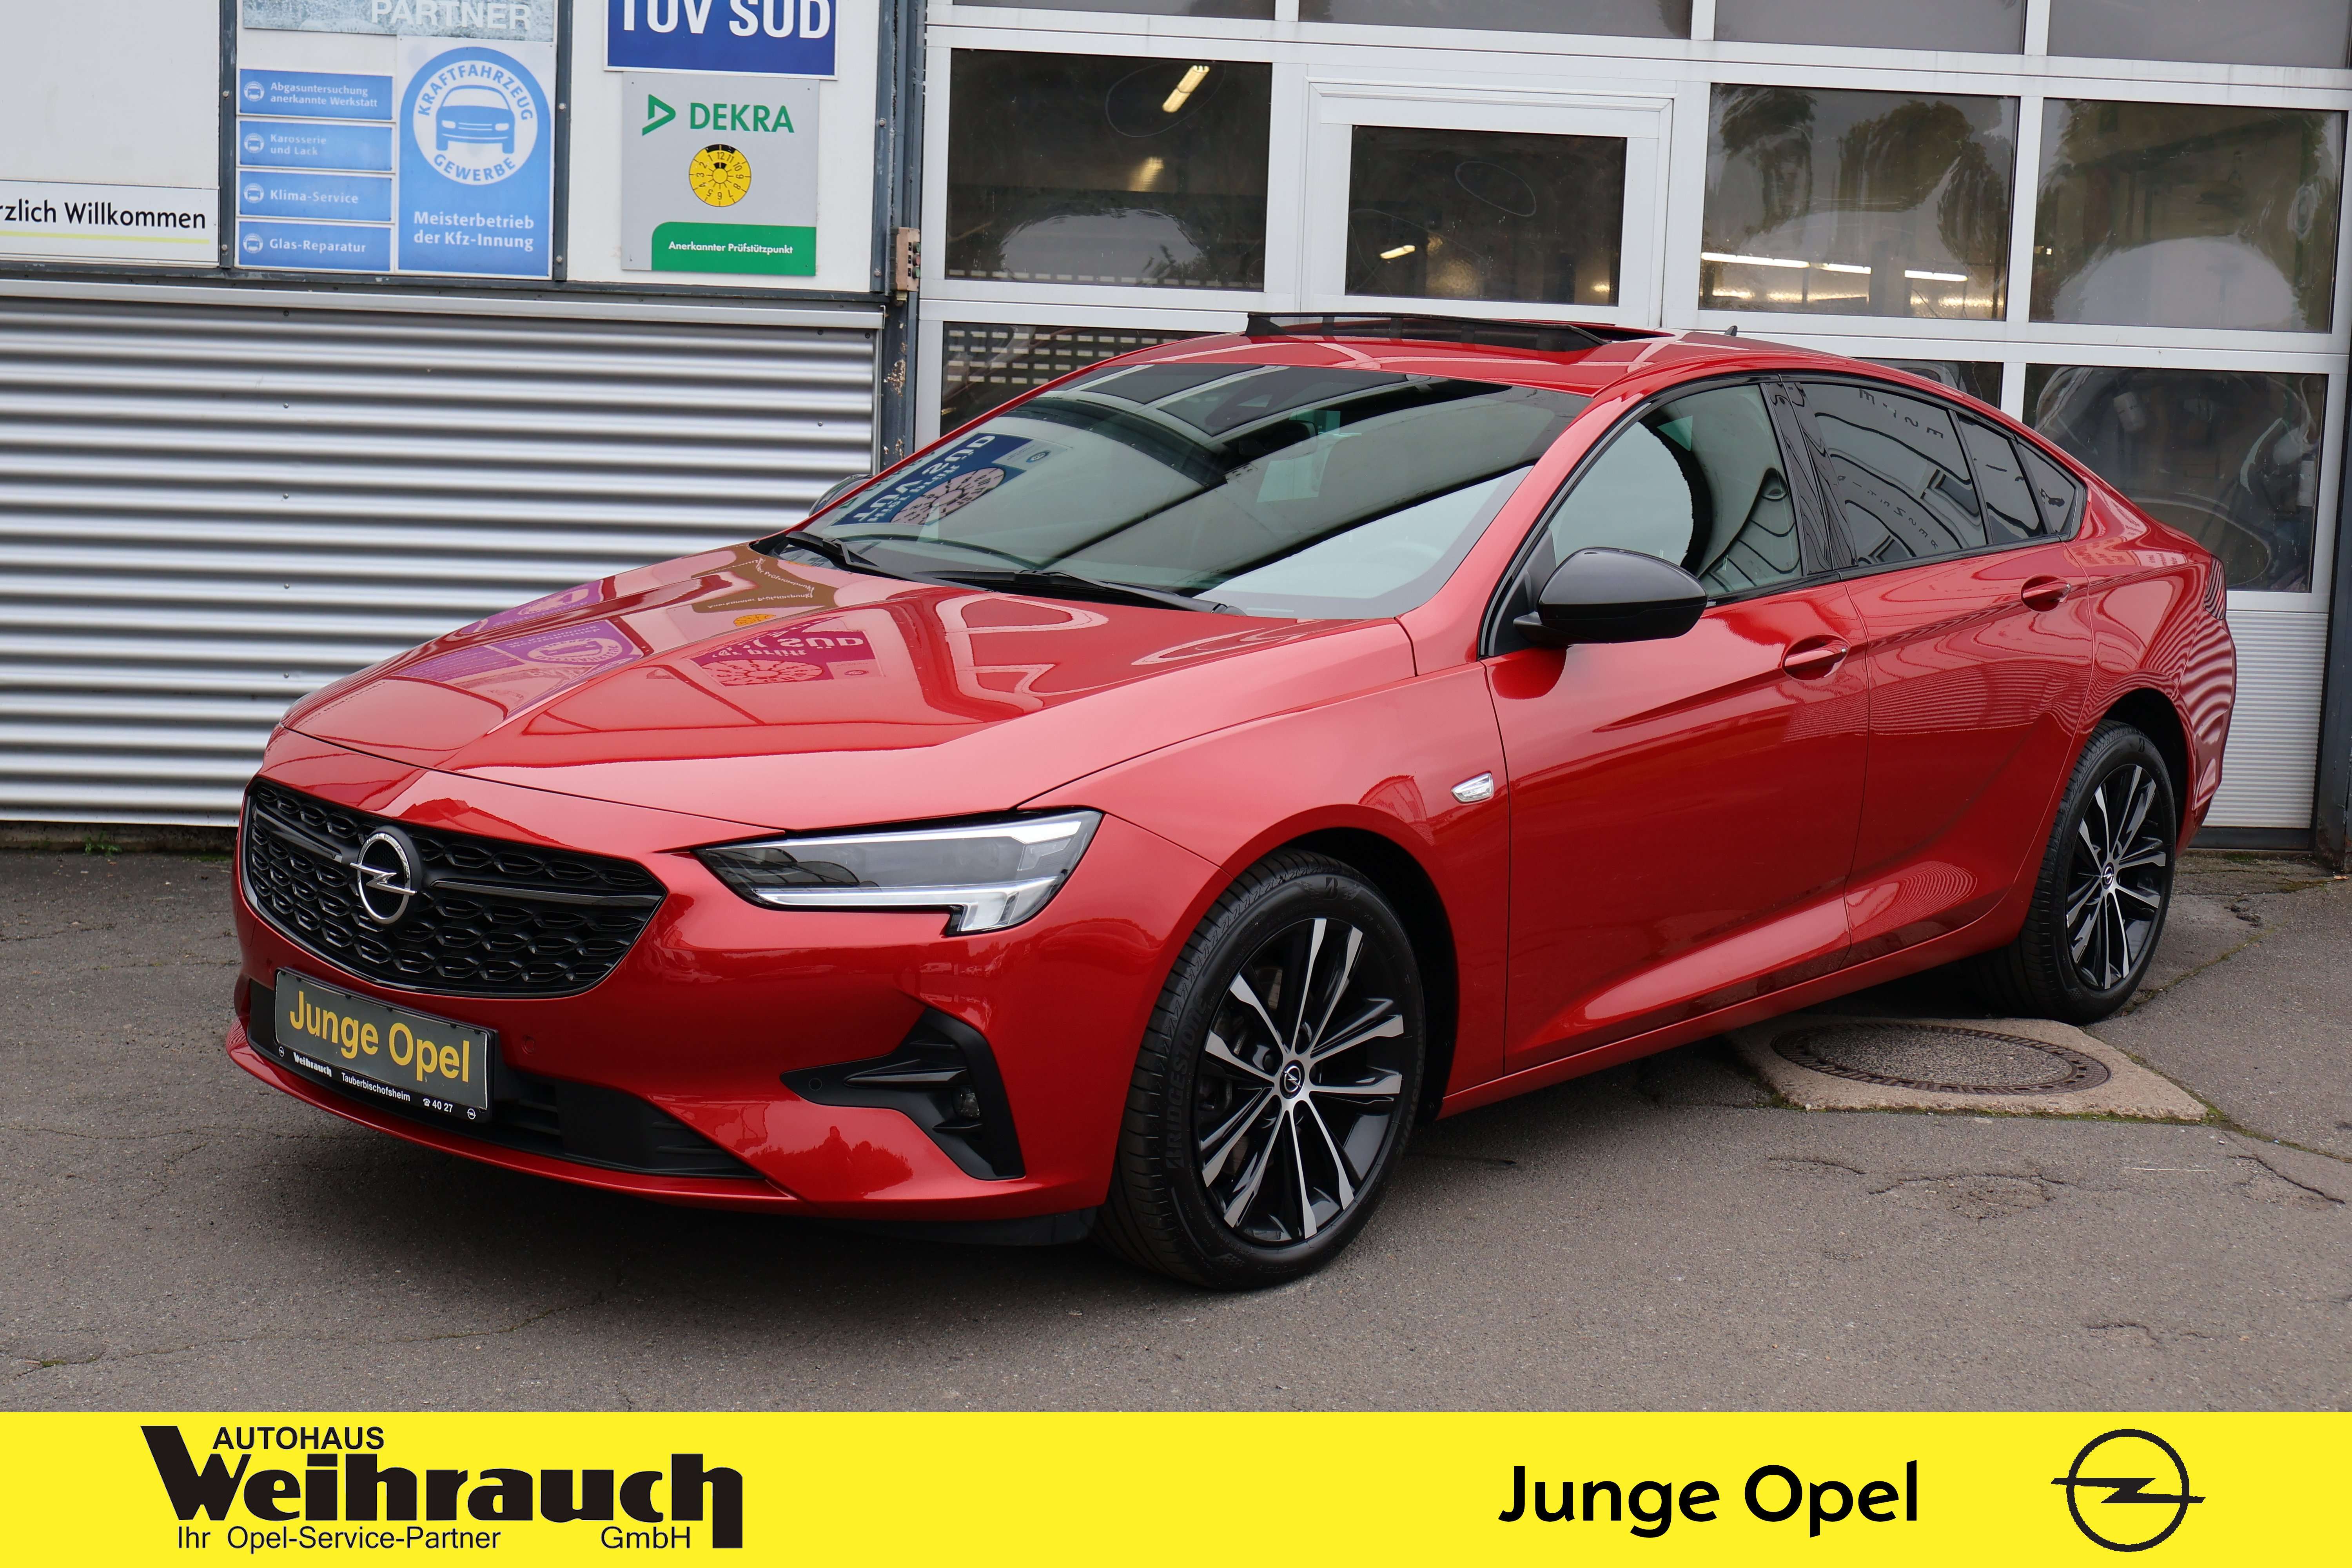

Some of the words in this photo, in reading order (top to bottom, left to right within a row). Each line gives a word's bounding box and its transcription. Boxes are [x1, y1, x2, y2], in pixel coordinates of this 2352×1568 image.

[372, 0, 531, 31] PARTNER
[270, 82, 368, 97] Abgasuntersuchung
[418, 64, 533, 120] KRAFTFAHRZEUG
[270, 96, 327, 105] anerkannte
[330, 98, 377, 108] Werkstatt
[690, 102, 795, 133] DEKRA
[270, 134, 326, 145] Karosserie
[270, 147, 291, 155] und
[294, 147, 318, 156] Lack
[727, 154, 734, 163] 11
[434, 154, 515, 181] GEWERBE
[733, 162, 742, 171] 10
[270, 190, 359, 204] Klima-Service
[64, 201, 206, 229] Willkommen
[414, 212, 534, 229] Meisterbetrieb
[269, 239, 366, 254] Glas-Reparatur
[414, 230, 443, 244] der
[445, 232, 534, 252] Kfz-Innung
[668, 241, 726, 252] Anerkannter
[728, 242, 793, 256] Prüfstützpunkt
[290, 991, 379, 1059] Junge
[389, 1022, 470, 1083] Opel
[293, 1051, 332, 1078] Weihrauch
[341, 1072, 411, 1102] Tauberbischofsheim
[432, 1100, 442, 1111] 40
[444, 1102, 453, 1113] 27
[1165, 991, 1207, 1169] BRIDGESTONE
